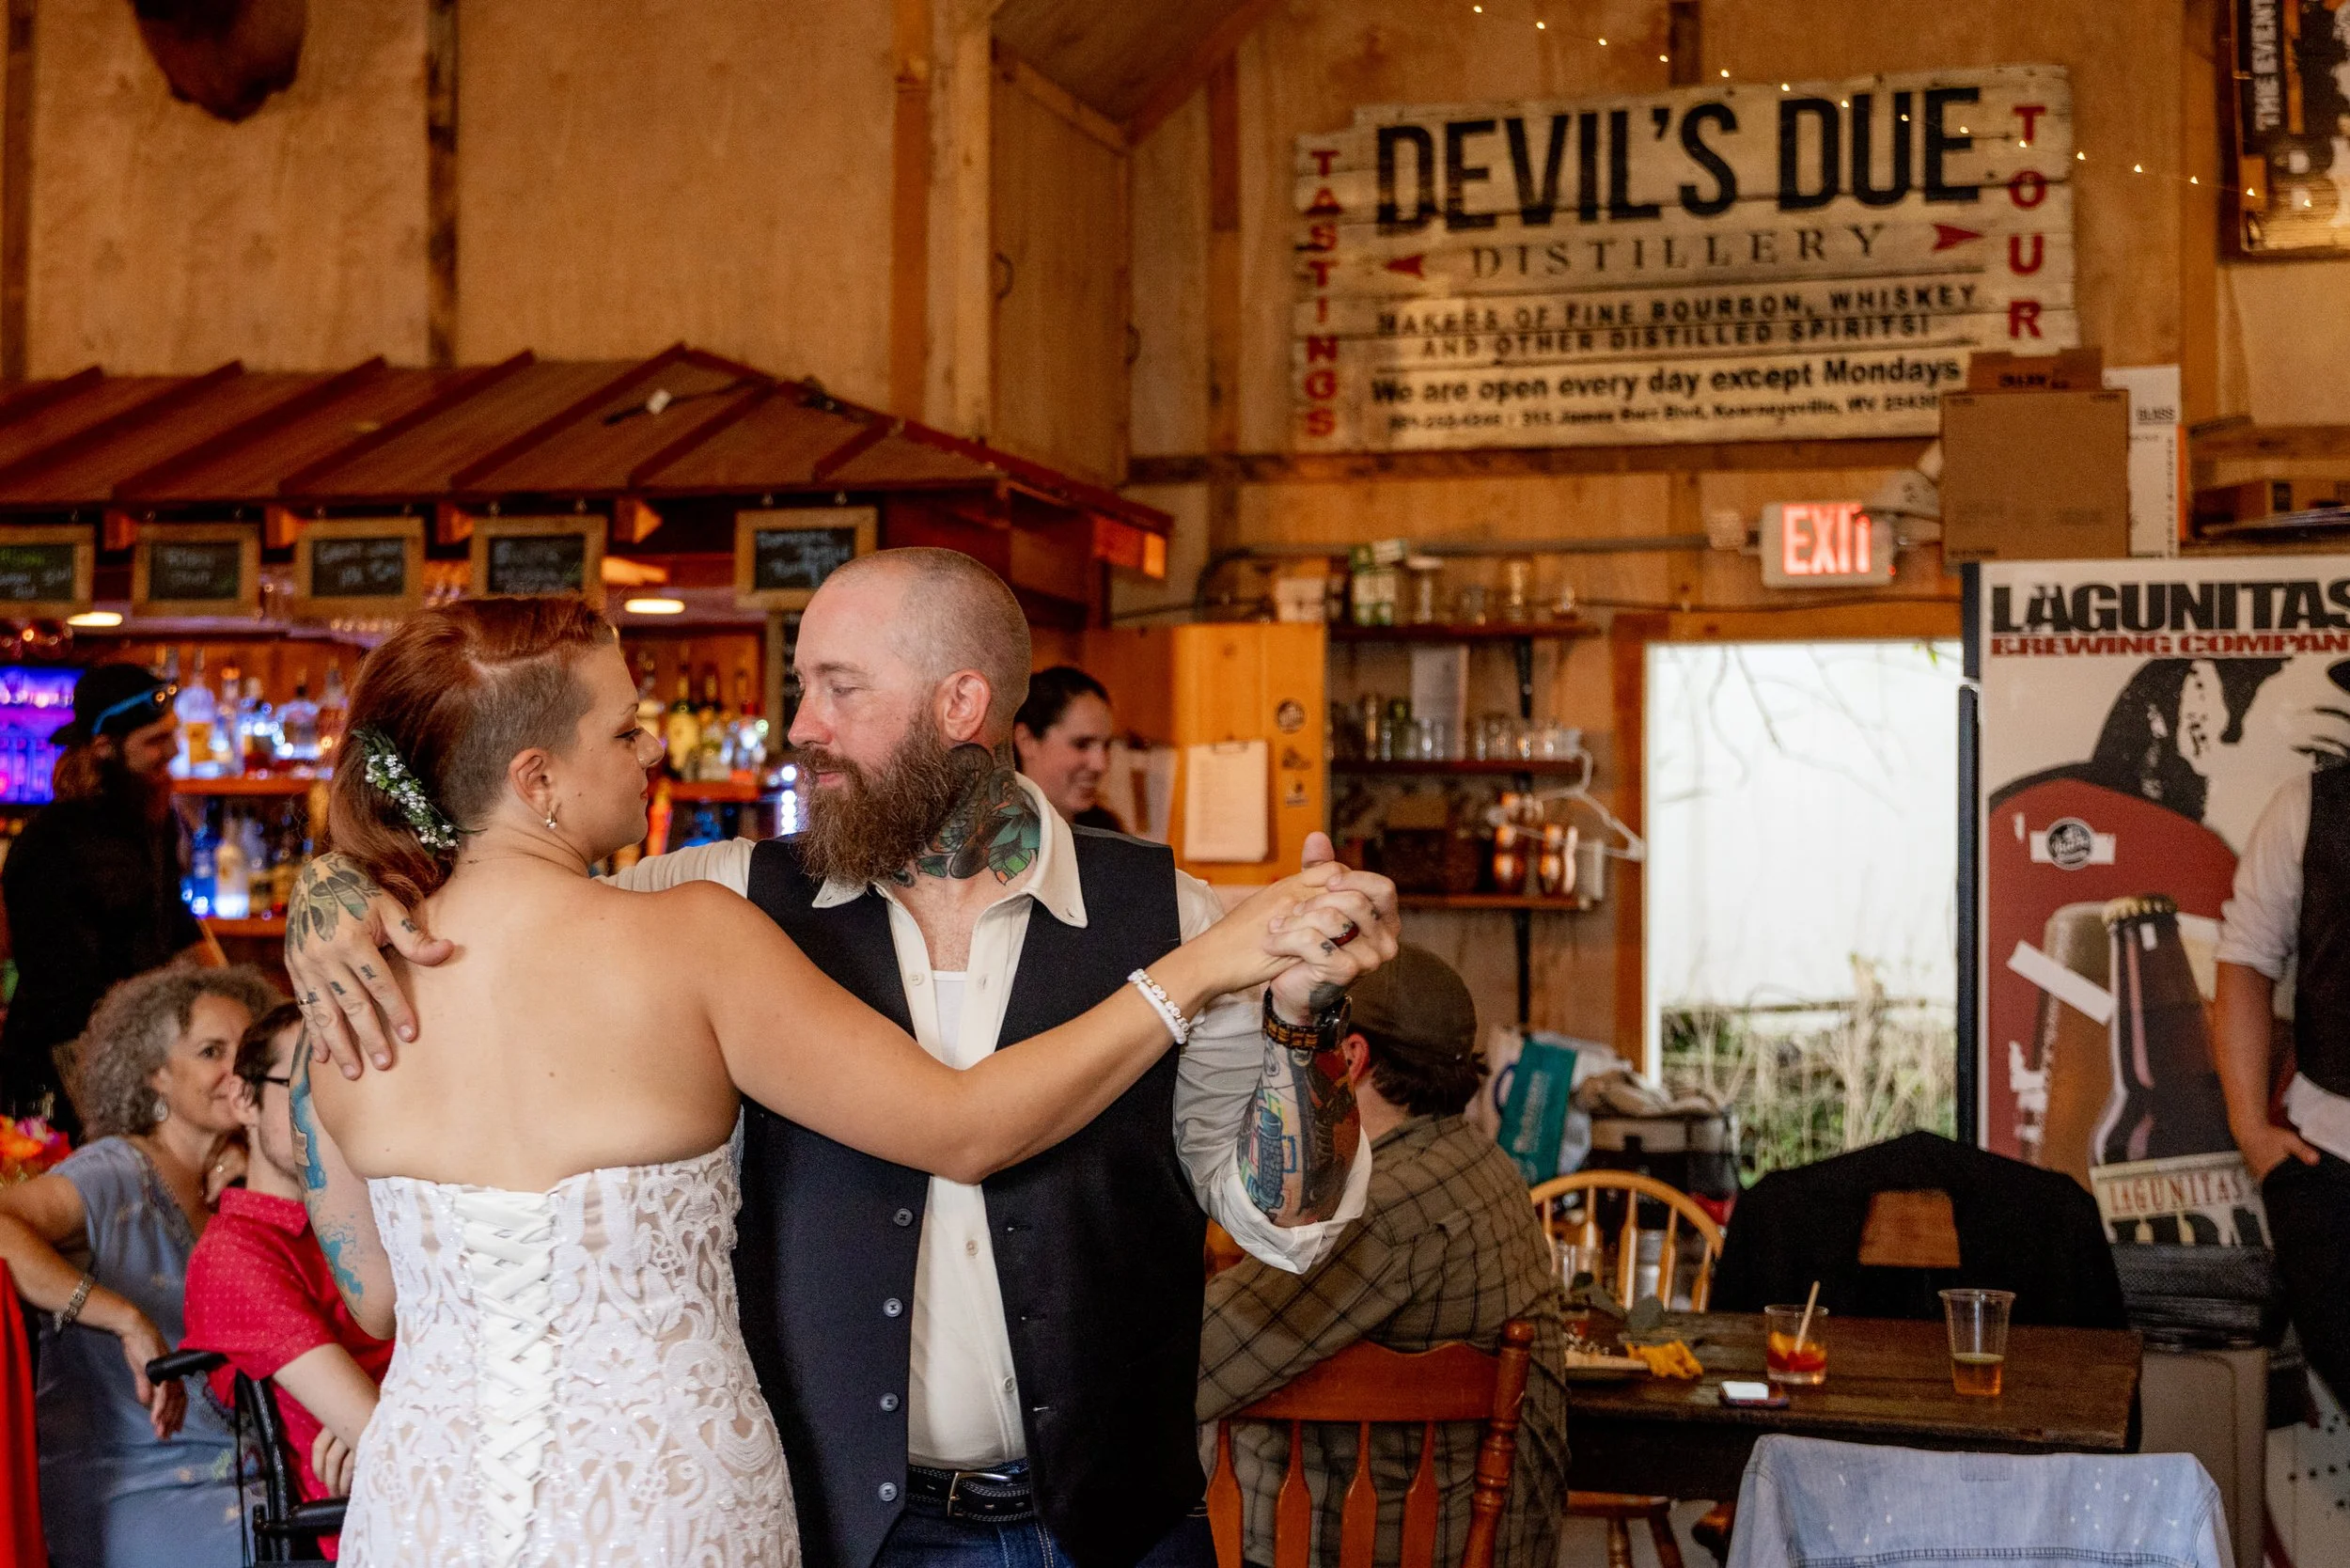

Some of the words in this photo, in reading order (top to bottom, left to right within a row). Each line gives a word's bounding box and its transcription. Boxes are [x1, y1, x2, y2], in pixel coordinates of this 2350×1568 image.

[1375, 102, 1737, 236] DEVIL'S
[1778, 87, 1981, 212] DUE
[2008, 105, 2047, 338] TOUR
[1471, 224, 1883, 279] DISTILLERY
[1305, 150, 1342, 437] TASTINGS
[1379, 306, 1498, 336] MAKERS
[1512, 306, 1549, 331] OF
[1566, 301, 1633, 328] FINE
[1652, 293, 1813, 324] BOURBON,
[1830, 285, 1978, 313] WHISKEY
[1422, 337, 1479, 357] AND
[1493, 331, 1593, 357] OTHER
[1610, 321, 1777, 350] DISTILLED
[1371, 380, 1414, 404] We
[1423, 381, 1468, 402] are
[1479, 376, 1548, 405] open
[1559, 372, 1638, 401] every
[1648, 365, 1700, 399] day
[1711, 364, 1813, 393] except
[1824, 355, 1962, 388] Mondays
[1782, 503, 1872, 573] EXIT
[1991, 578, 2350, 633] LAGUNITAS
[1990, 634, 2171, 656] BREWING
[2108, 1169, 2244, 1212] LAGUNITAS
